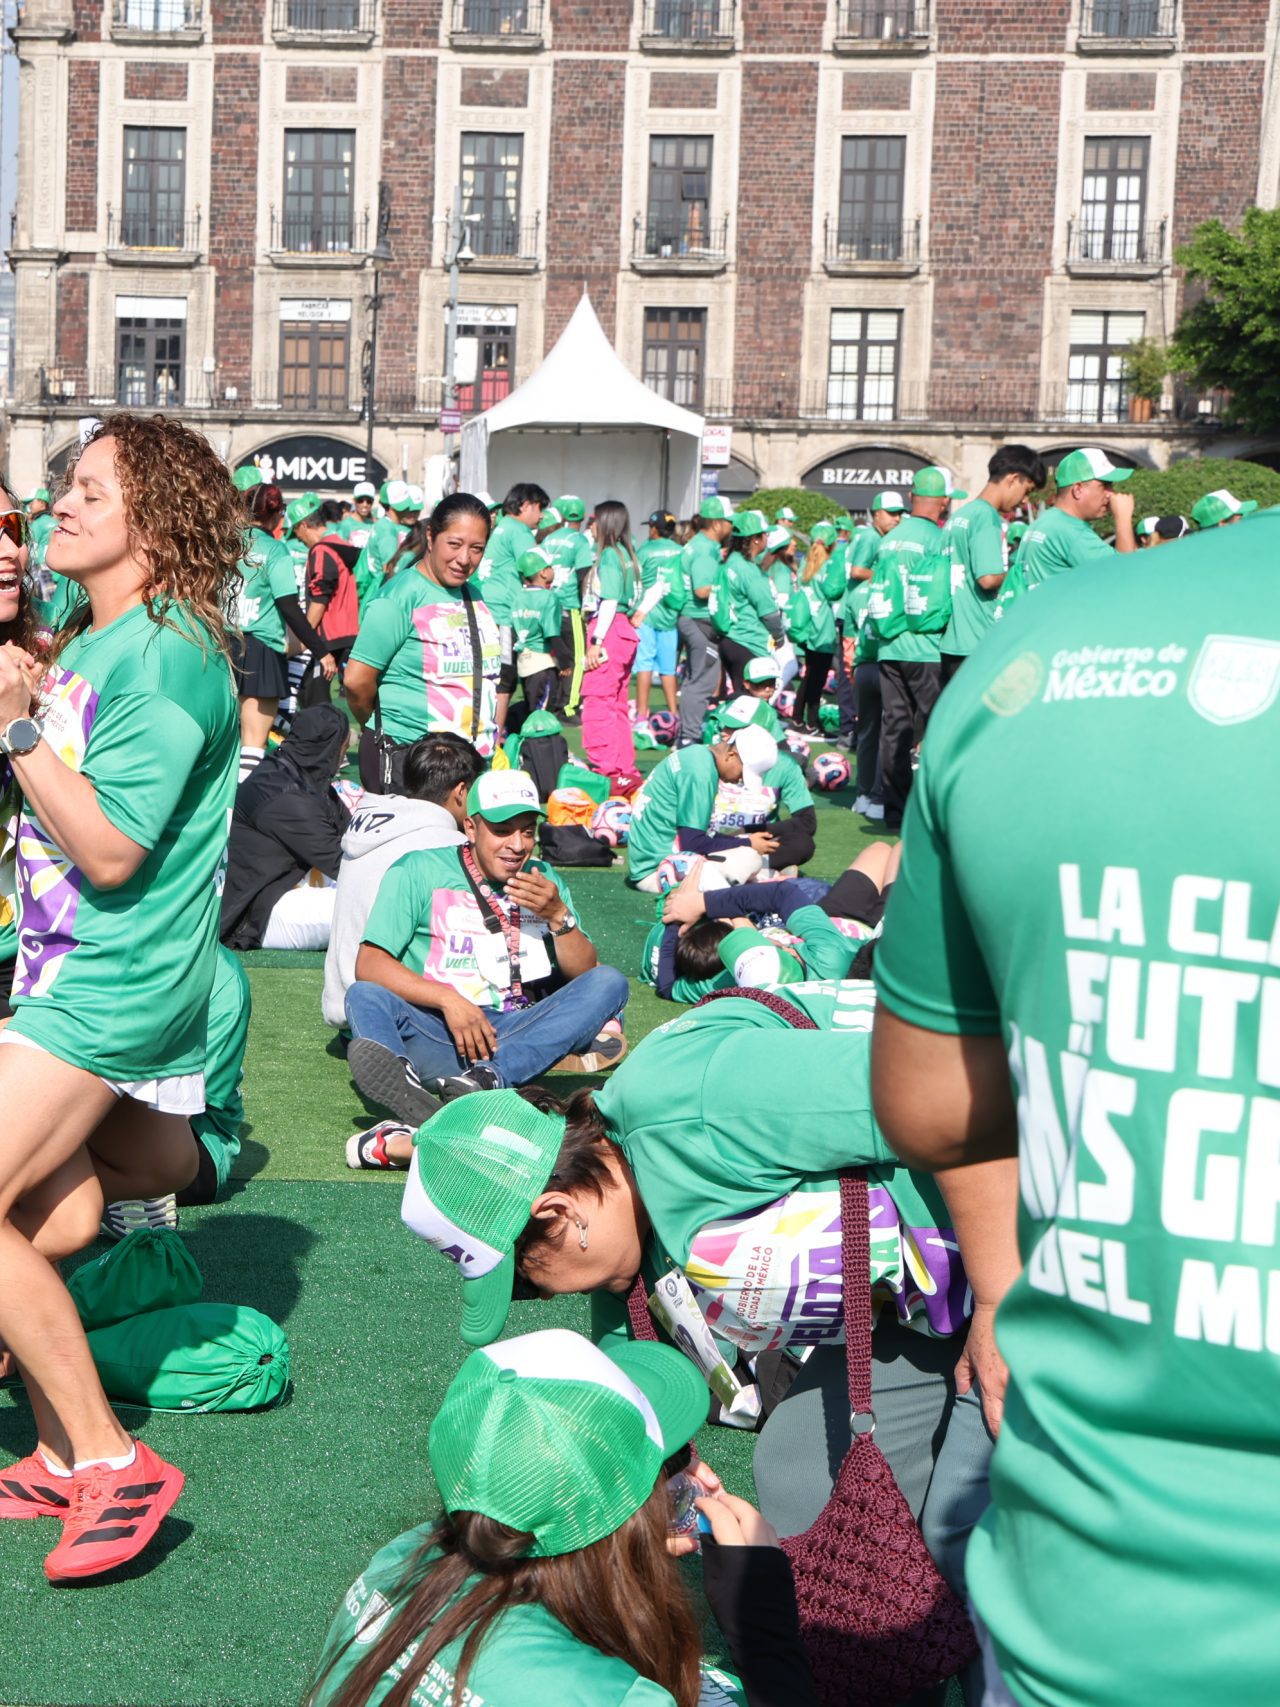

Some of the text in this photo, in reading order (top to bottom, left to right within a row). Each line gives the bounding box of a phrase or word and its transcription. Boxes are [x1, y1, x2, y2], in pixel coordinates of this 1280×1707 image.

[276, 456, 367, 481] MIXUE
[443, 661, 473, 673] VUEL
[1052, 643, 1187, 668] Gobierno de
[1042, 662, 1177, 703] México
[1059, 863, 1280, 968] LA CL
[449, 935, 473, 954] LA
[1066, 949, 1280, 1089] FUT
[736, 1245, 762, 1318] GOBIERNO DE LA
[747, 1297, 759, 1320] CIUDAD
[759, 1247, 773, 1286] MÉXICO
